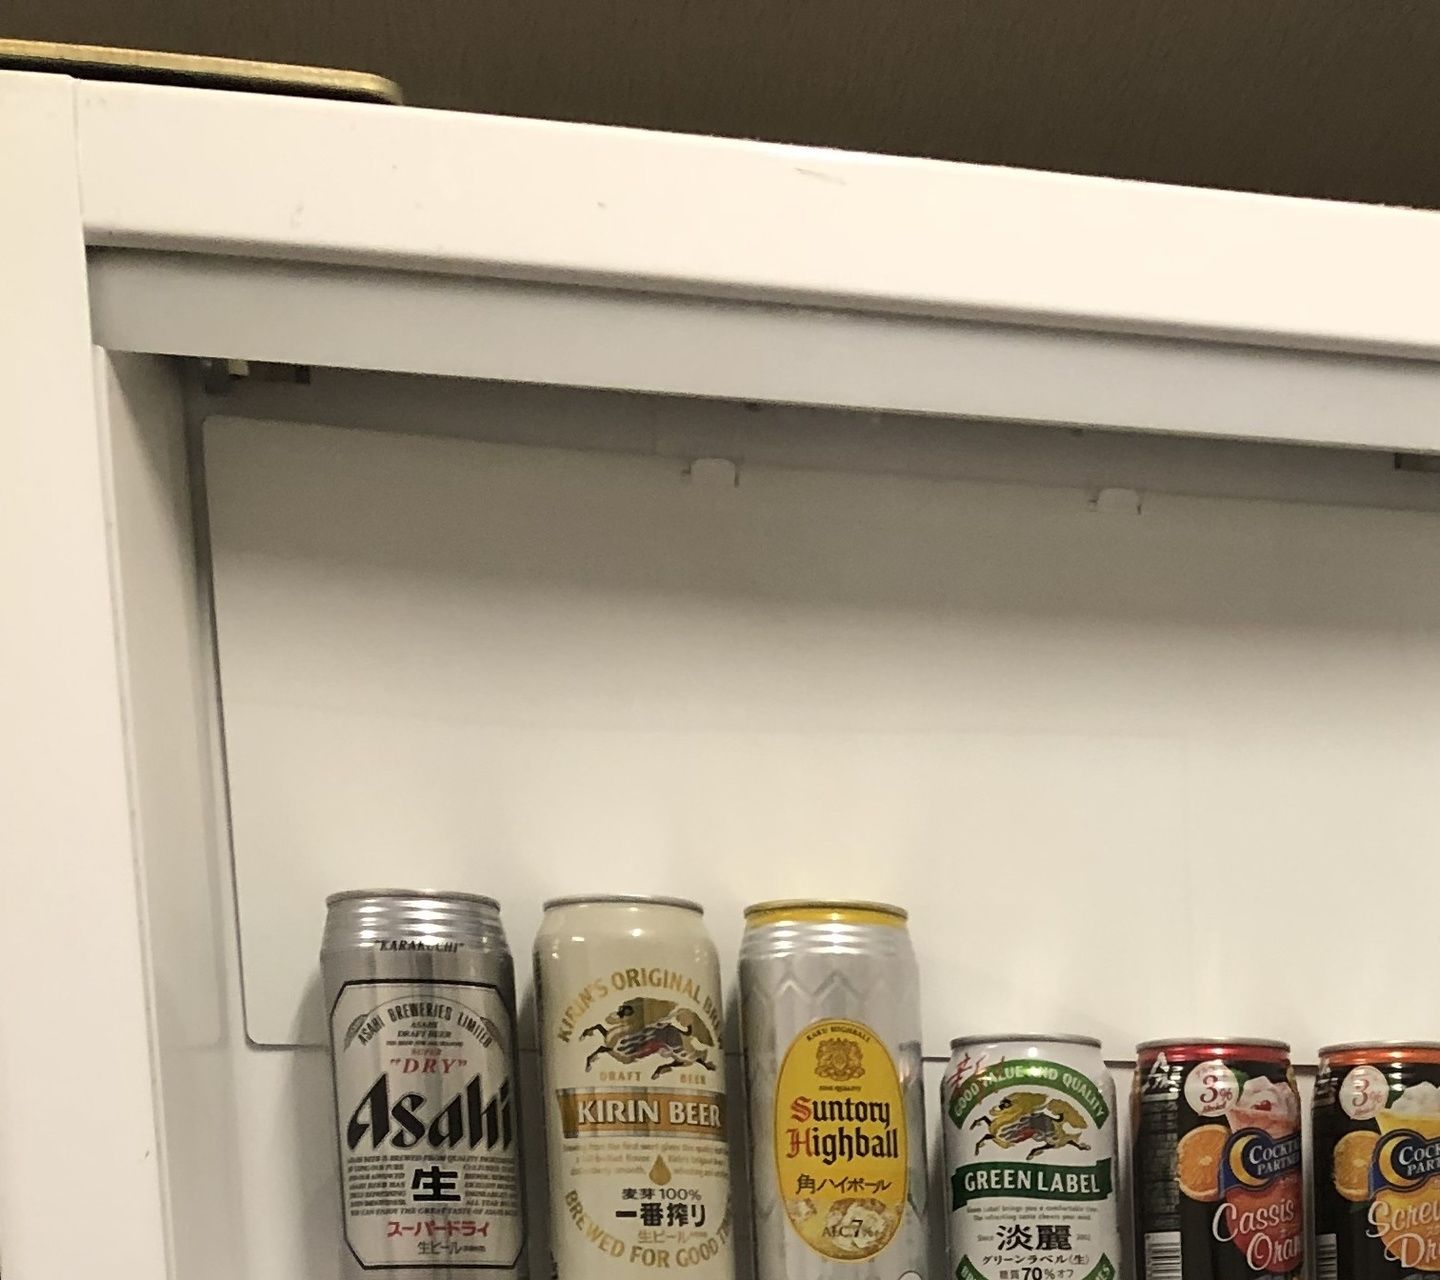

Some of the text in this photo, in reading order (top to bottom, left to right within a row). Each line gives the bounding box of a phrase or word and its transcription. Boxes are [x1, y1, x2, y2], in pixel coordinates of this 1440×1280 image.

[557, 967, 702, 1043] KIRIN'S ORIGINAL
[387, 1002, 453, 1022] BREWERIES
[457, 1011, 493, 1048] LIMITED
[600, 1071, 706, 1085] DRAFT BEER
[1200, 1074, 1234, 1104] 3%
[347, 1072, 513, 1151] Asahi
[955, 1083, 980, 1117] GOOD
[1062, 1073, 1105, 1118] QUALITY
[578, 1100, 722, 1128] KIRIN BEER
[789, 1096, 891, 1130] Suntory
[786, 1126, 899, 1166] Highball
[411, 1165, 462, 1201] 生
[622, 1187, 702, 1201] 麦芽100%
[795, 1173, 893, 1196] 角ハイボール
[964, 1169, 1101, 1194] GREEN LABEL
[387, 1221, 490, 1238] スーパードライ
[564, 1190, 719, 1269] BREWED FOR GOOD
[615, 1202, 706, 1228] 一番搾り
[1211, 1198, 1295, 1242] Cassis
[996, 1224, 1073, 1251] 淡麗
